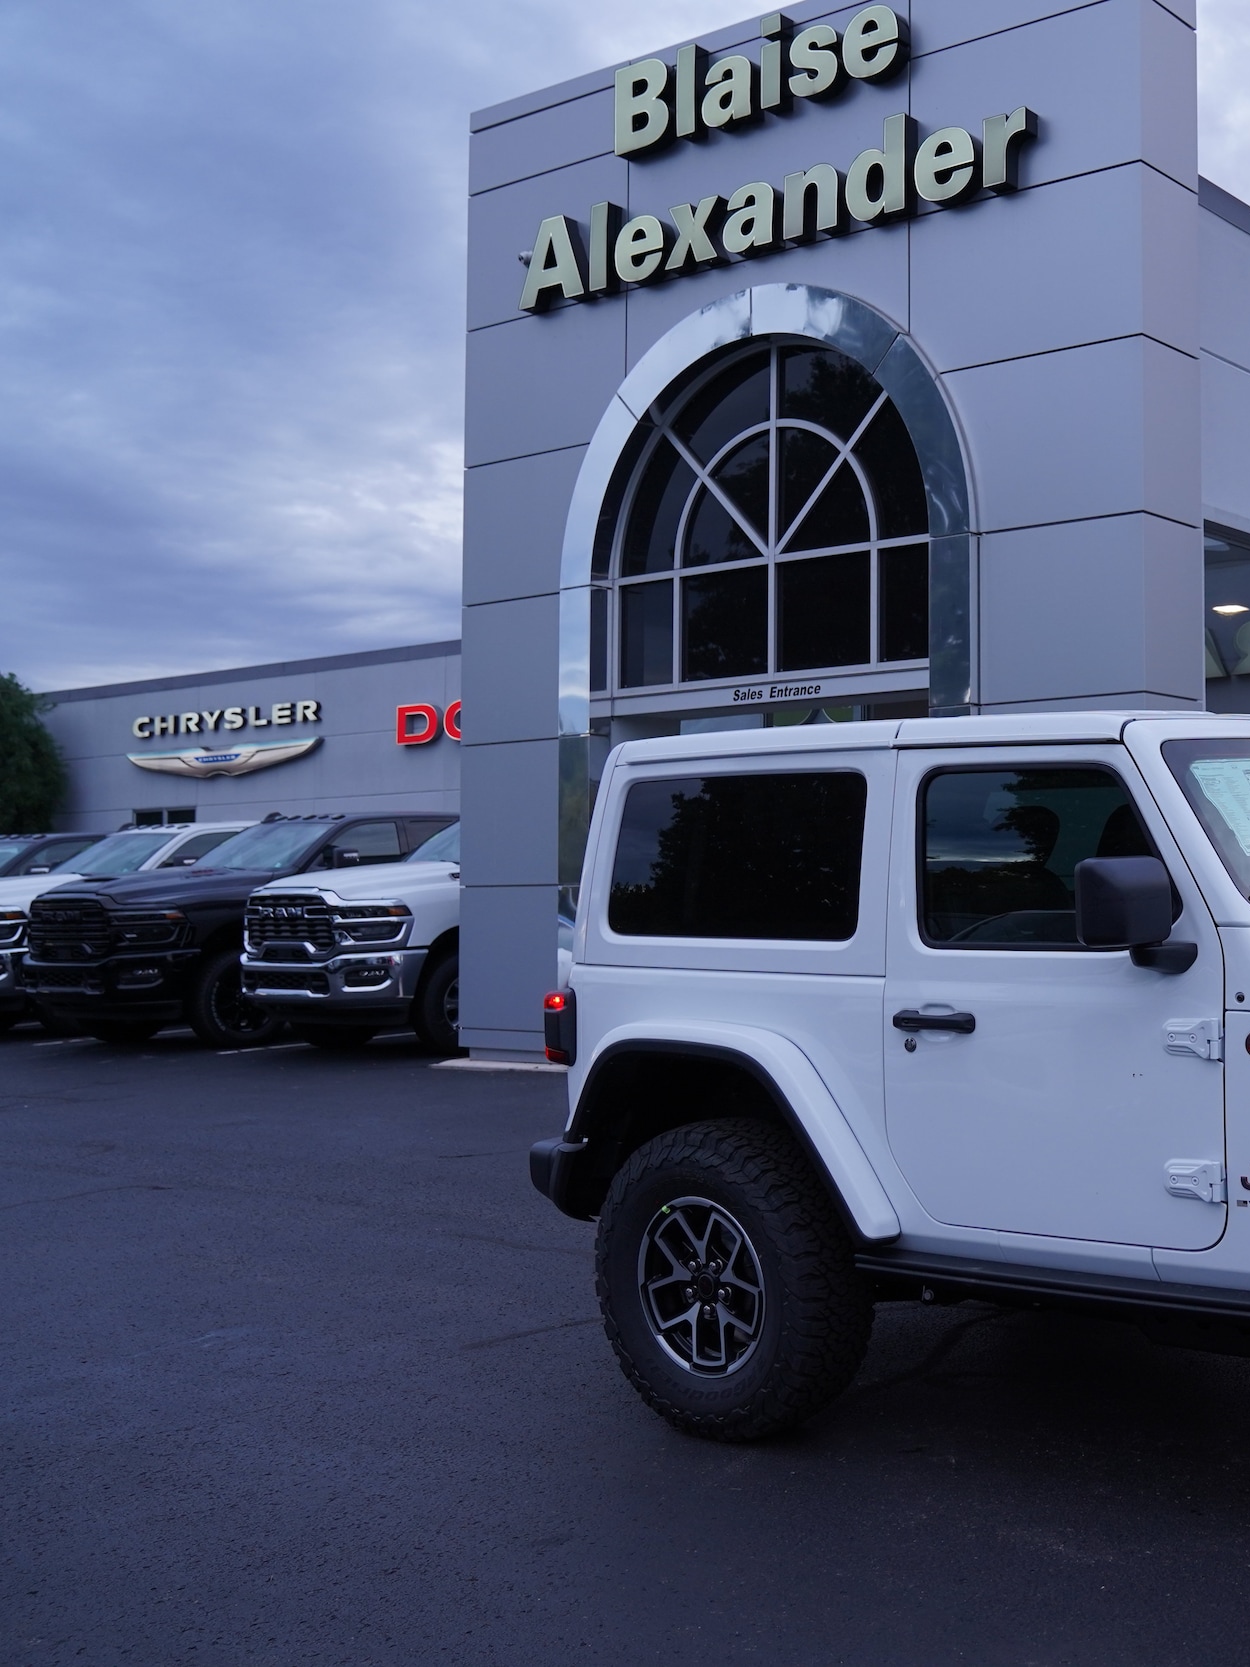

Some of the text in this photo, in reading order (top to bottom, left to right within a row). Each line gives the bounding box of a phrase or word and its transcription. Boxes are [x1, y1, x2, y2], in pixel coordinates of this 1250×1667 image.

[614, 4, 905, 158] Blaise
[518, 106, 1031, 311] Alexander
[132, 700, 318, 738] CHRYSLER
[733, 685, 821, 702] Sales Entrance
